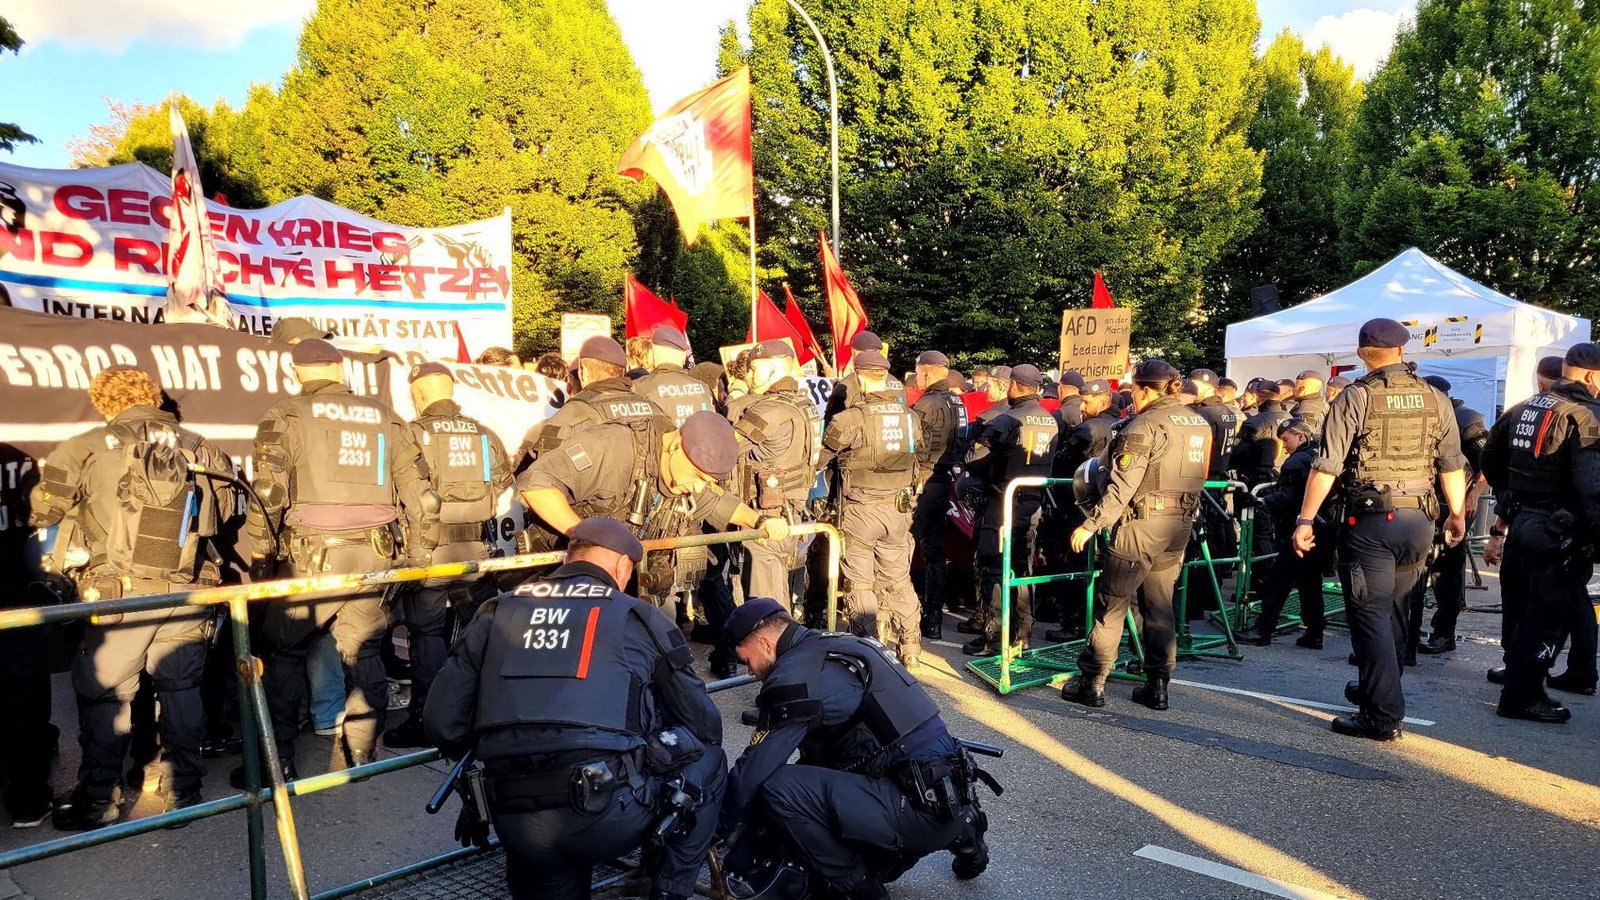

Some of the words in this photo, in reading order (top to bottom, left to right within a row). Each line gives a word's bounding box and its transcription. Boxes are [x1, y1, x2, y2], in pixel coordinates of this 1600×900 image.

[267, 217, 411, 257] KRIEG
[114, 236, 316, 288] RCHTE
[1072, 340, 1121, 357] bedeutet
[151, 344, 221, 391] HAT
[236, 347, 379, 396] SYSM!
[657, 383, 705, 399] POLIZEI
[610, 402, 654, 417] POLIZEI
[1386, 394, 1425, 410] POLIZEI
[312, 402, 382, 425] POLIZEI
[1521, 409, 1539, 422] BW
[433, 419, 479, 434] POLIZEI
[1515, 423, 1535, 437] 1330
[341, 430, 368, 449] BW
[449, 436, 473, 451] BW
[337, 449, 372, 467] 2331
[448, 450, 477, 467] 2331
[514, 582, 613, 598] POLIZEI
[529, 606, 570, 626] BW
[521, 627, 571, 650] 1331
